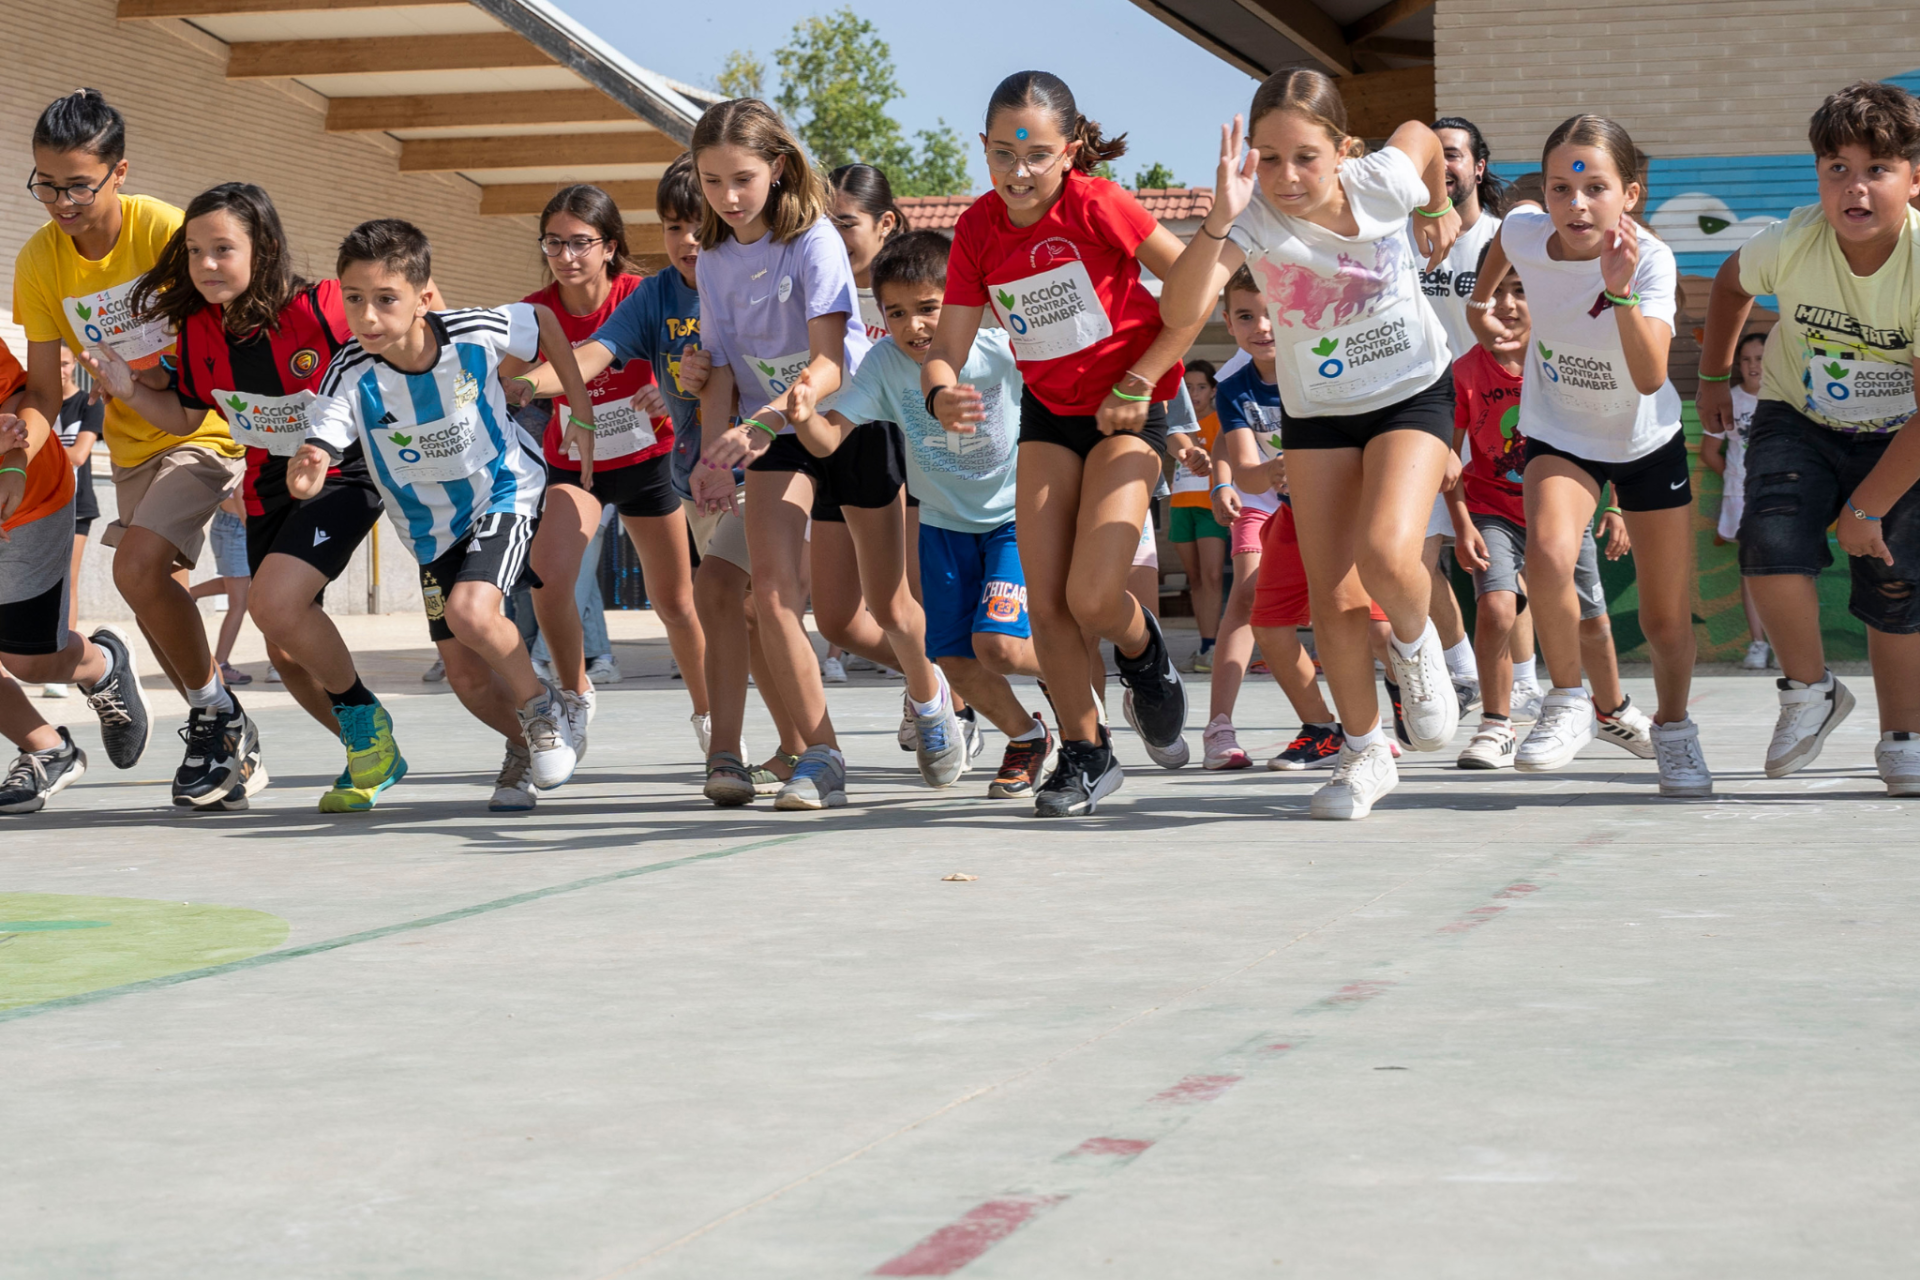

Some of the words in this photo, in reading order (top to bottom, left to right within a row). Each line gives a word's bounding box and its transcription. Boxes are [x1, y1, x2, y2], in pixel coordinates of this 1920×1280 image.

[1021, 279, 1077, 307] ACCIÓN
[1025, 296, 1067, 317] CONTRA
[1068, 292, 1081, 304] EL
[1029, 301, 1086, 329] HAMBRE
[1345, 317, 1405, 349] ACCIÓN
[1346, 335, 1395, 358] CONTRA
[1396, 330, 1408, 341] EL
[1348, 339, 1411, 369] HAMBRE
[1558, 354, 1613, 372] ACCIÓN
[1559, 366, 1602, 381] CONTRA
[1602, 373, 1615, 381] EL
[1561, 375, 1618, 391] HAMBRE
[1854, 368, 1914, 381] ACCIÓN
[1854, 380, 1904, 389] CONTRA
[253, 402, 306, 417] ACCIÓN
[253, 415, 298, 425] CONTRA
[297, 413, 308, 421] EL
[255, 419, 310, 434] HAMBRE
[419, 417, 470, 445] ACCIÓN
[595, 418, 629, 431] ONTRA
[595, 420, 640, 440] HAMBRE
[421, 435, 465, 450] CONTRA
[464, 428, 472, 438] EL
[424, 433, 476, 459] HAMBRE
